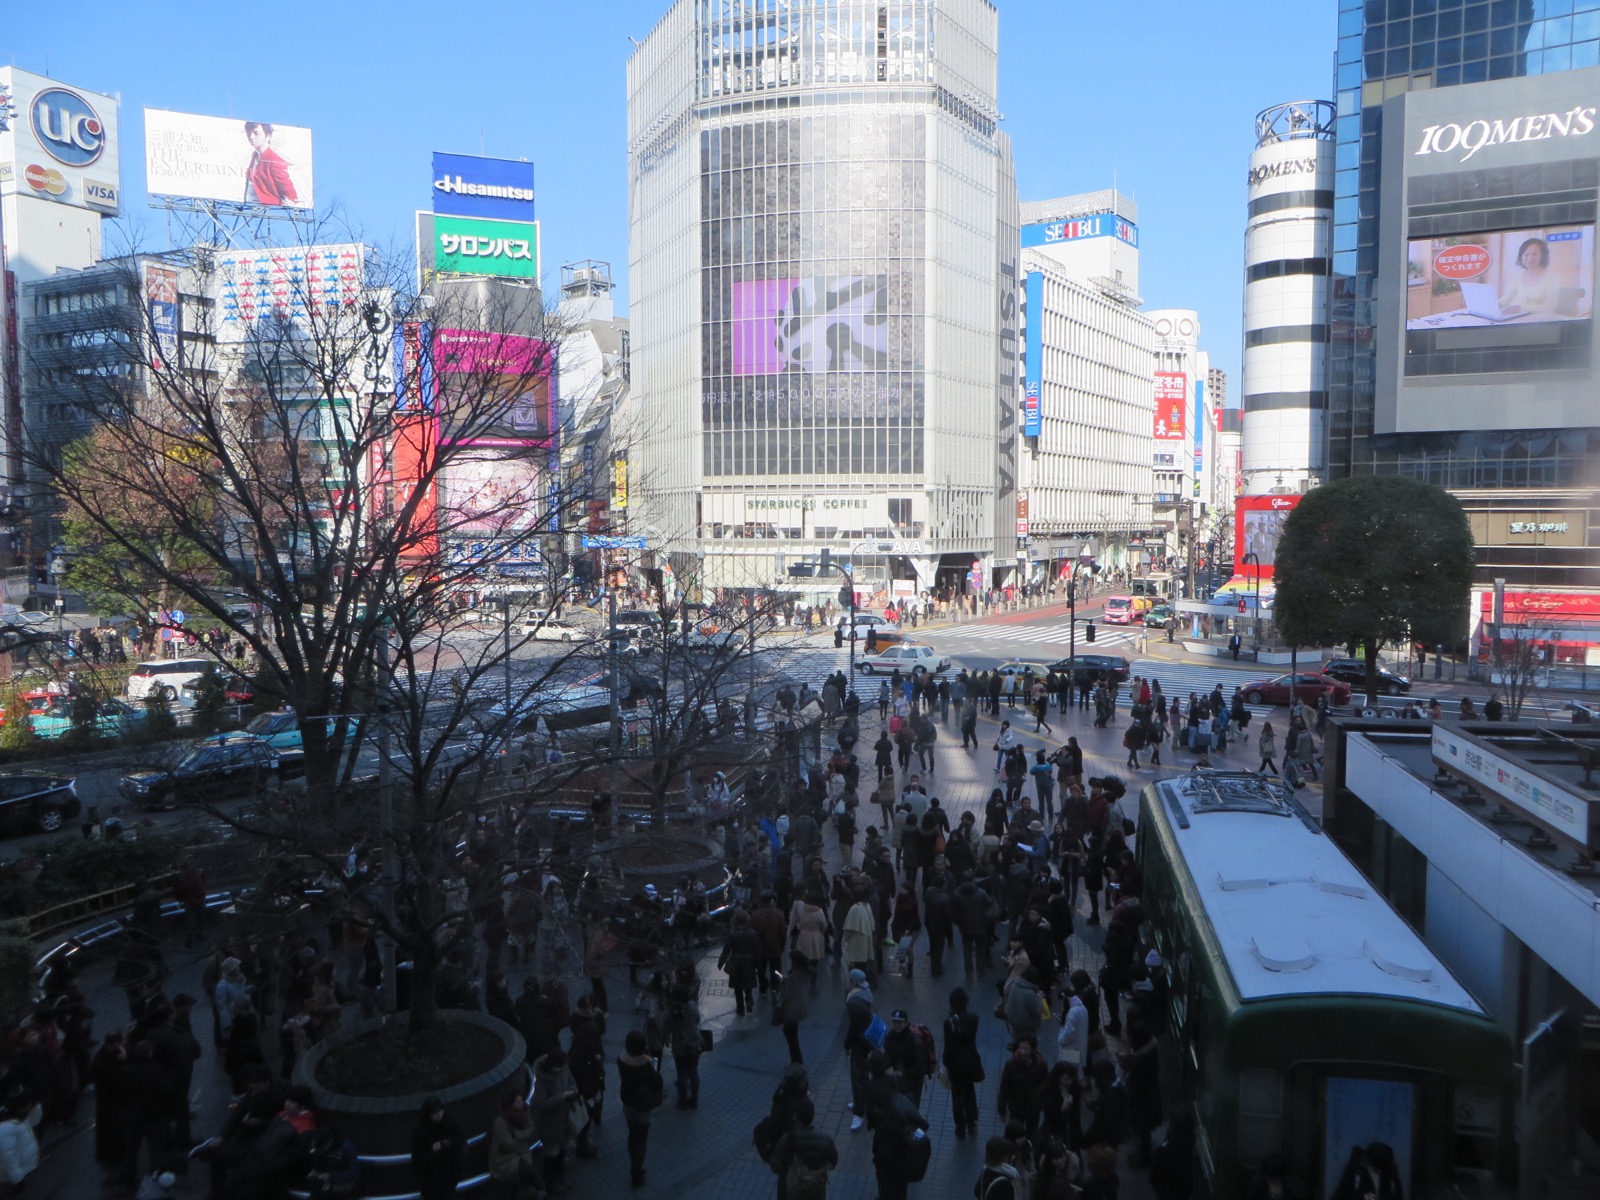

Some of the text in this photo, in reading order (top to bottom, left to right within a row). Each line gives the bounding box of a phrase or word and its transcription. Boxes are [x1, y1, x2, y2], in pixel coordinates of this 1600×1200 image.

[1414, 105, 1597, 163] 109MEN'S
[87, 184, 116, 201] VISA
[434, 174, 534, 201] Hisamitsu
[1044, 217, 1101, 243] SEIBU
[1115, 219, 1137, 246] SEIBU
[440, 233, 532, 260] サロンパス
[1438, 252, 1486, 265] 確定申告書が
[1442, 262, 1482, 273] つくれます
[998, 257, 1017, 500] TSUTAYA
[1026, 382, 1038, 427] SEIBU
[747, 498, 868, 511] STARBUCKS COFFEE
[1271, 498, 1292, 509] Glico
[1510, 521, 1569, 533] 星乃珈琲
[853, 540, 922, 553] TSUAYA
